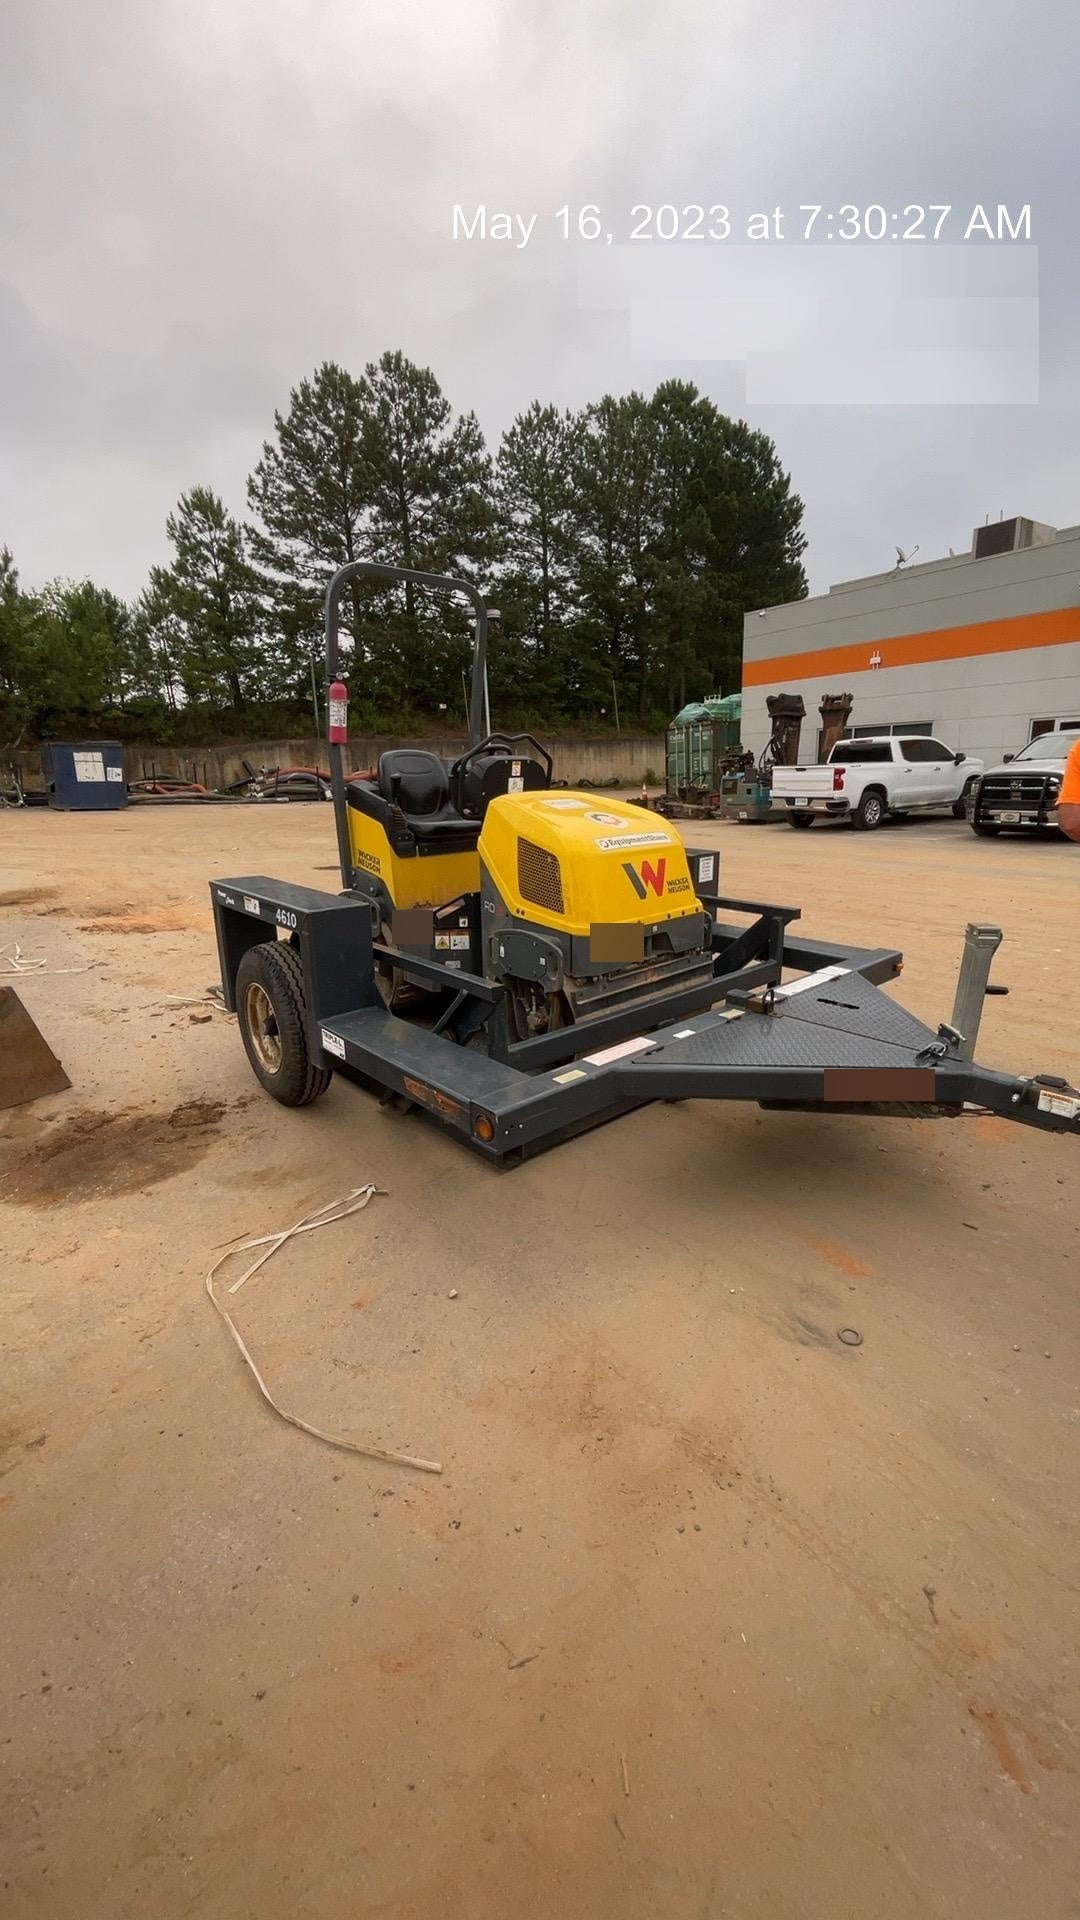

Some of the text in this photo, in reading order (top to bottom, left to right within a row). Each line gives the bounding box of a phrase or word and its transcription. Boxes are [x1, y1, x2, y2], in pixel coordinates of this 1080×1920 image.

[607, 834, 669, 847] EquipmentShare
[666, 877, 689, 887] WACKER
[667, 884, 690, 894] NEUSON
[275, 908, 297, 928] 4610
